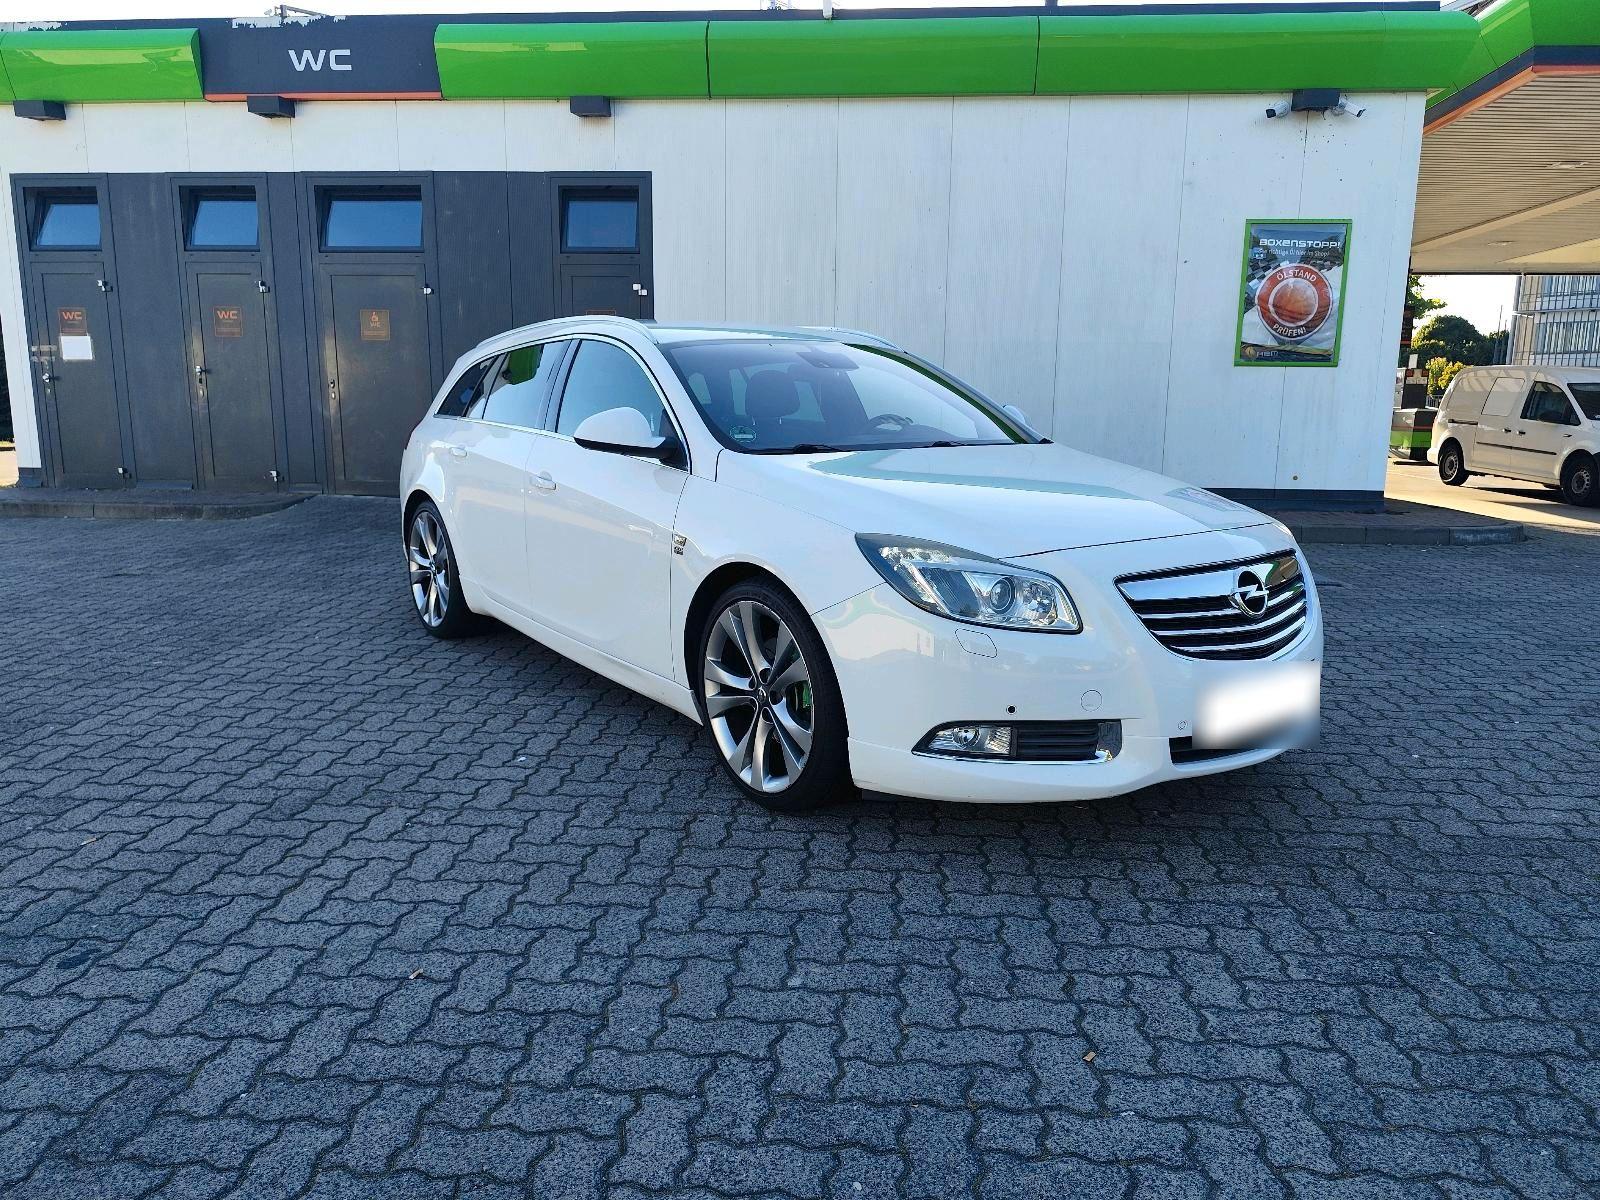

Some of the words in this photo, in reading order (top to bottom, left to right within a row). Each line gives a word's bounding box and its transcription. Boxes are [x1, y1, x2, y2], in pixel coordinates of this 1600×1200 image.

[288, 49, 352, 71] WC
[1276, 269, 1317, 282] ÖLSTAND
[62, 311, 82, 320] WC
[217, 310, 238, 319] WC
[1273, 323, 1307, 337] PRÜFEN!
